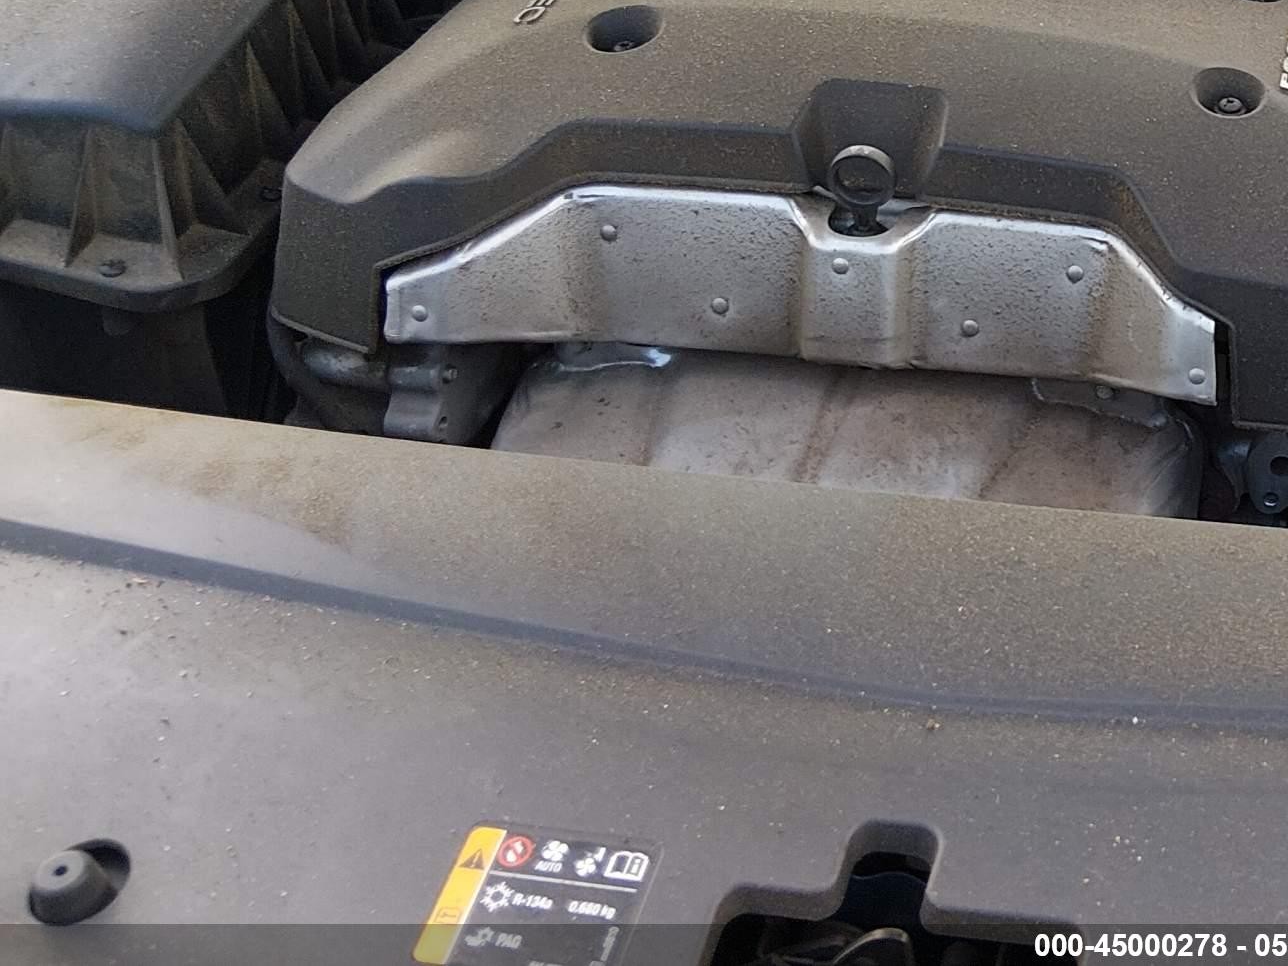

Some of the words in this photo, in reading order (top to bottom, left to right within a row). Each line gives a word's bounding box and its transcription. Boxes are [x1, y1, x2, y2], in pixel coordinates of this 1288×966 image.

[534, 860, 563, 873] AUTO
[511, 892, 554, 910] R-134a
[495, 933, 523, 949] PAG
